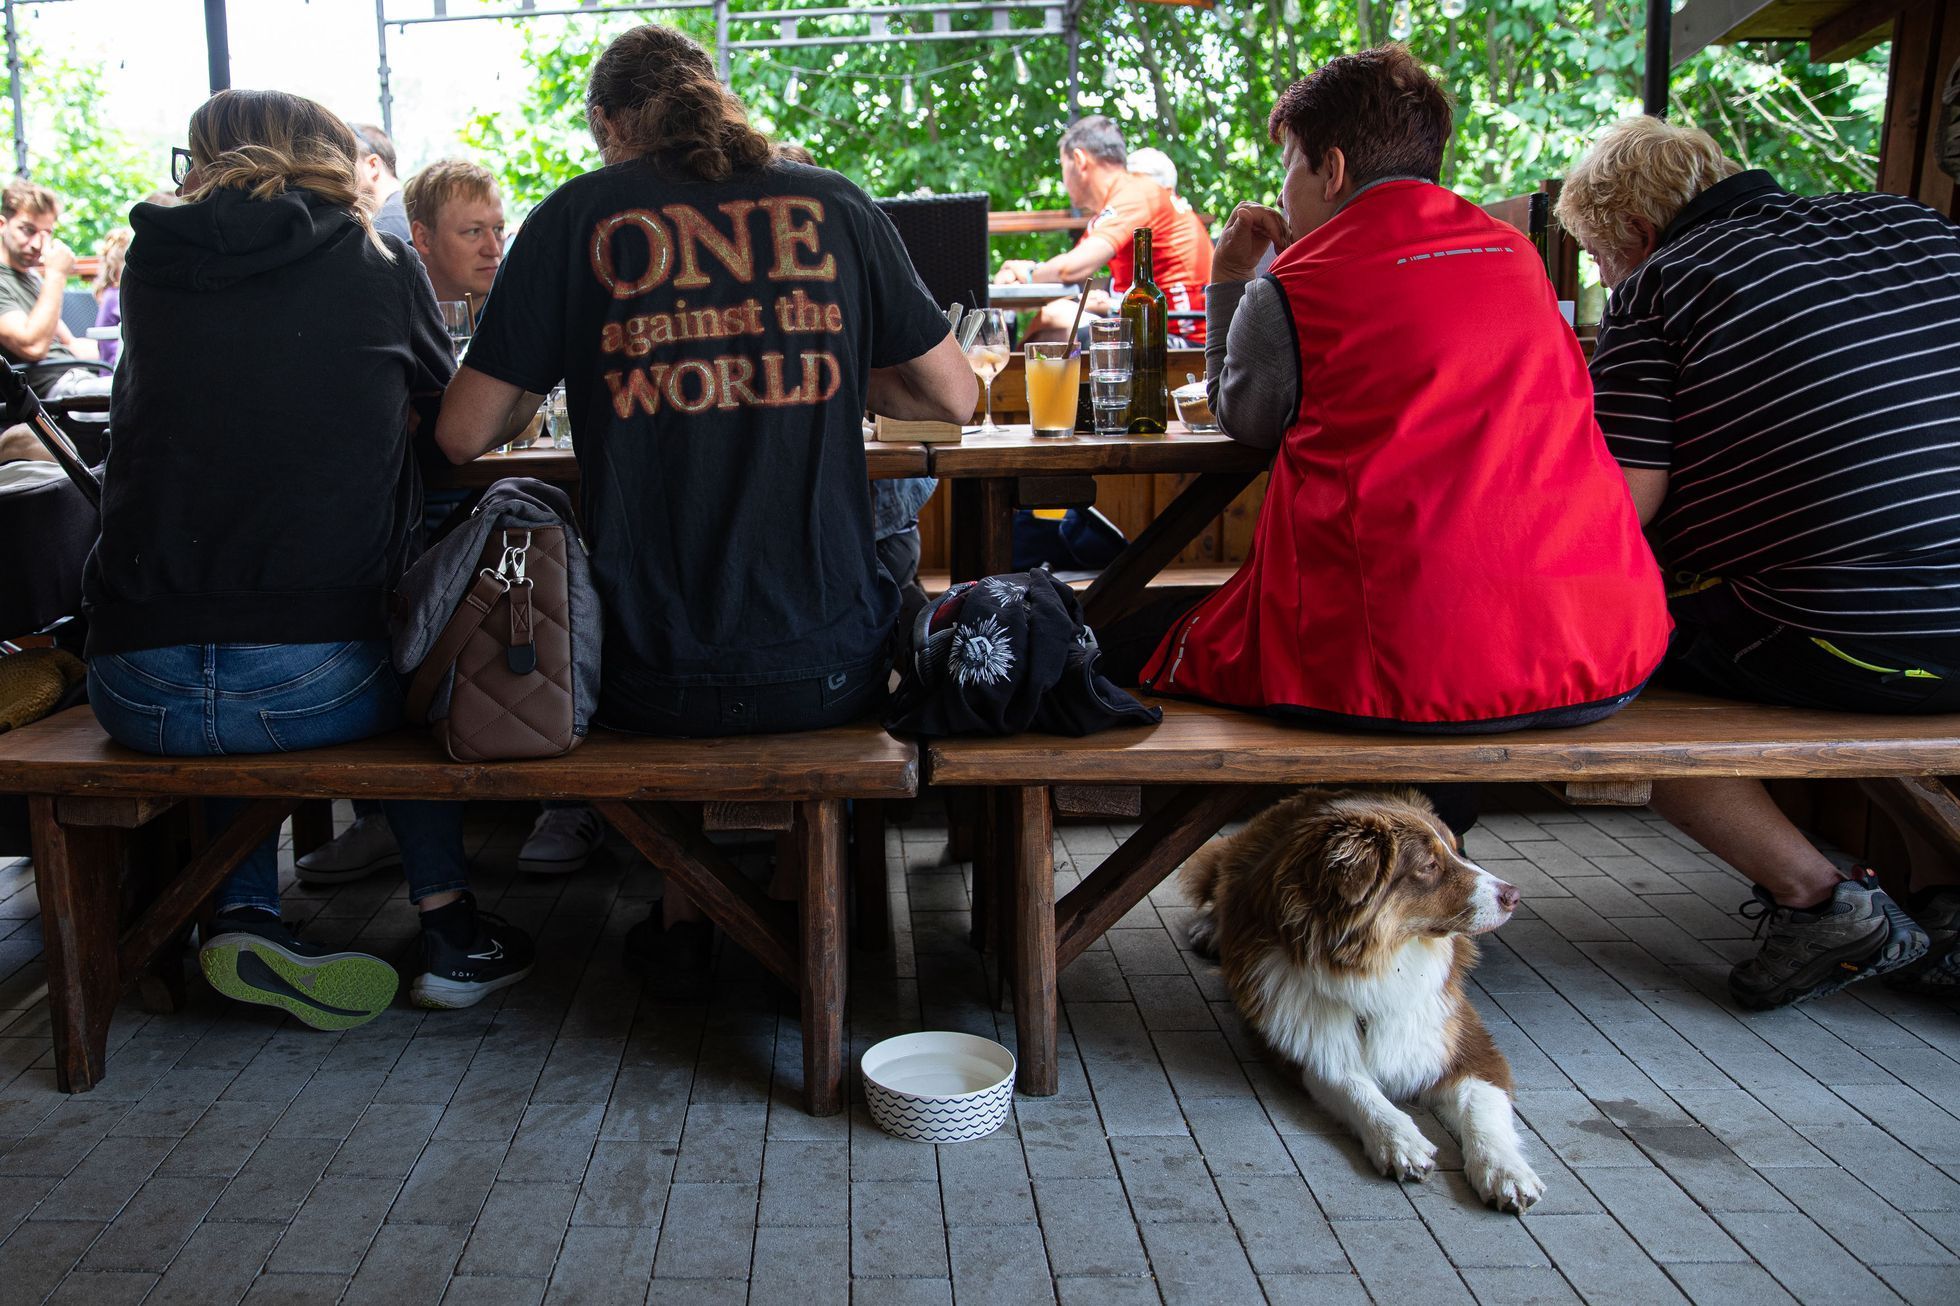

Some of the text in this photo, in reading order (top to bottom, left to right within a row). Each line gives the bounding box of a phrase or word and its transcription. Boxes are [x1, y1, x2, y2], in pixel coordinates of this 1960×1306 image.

[590, 195, 837, 299] ONE
[601, 289, 843, 356] against the
[603, 352, 842, 420] WORLD
